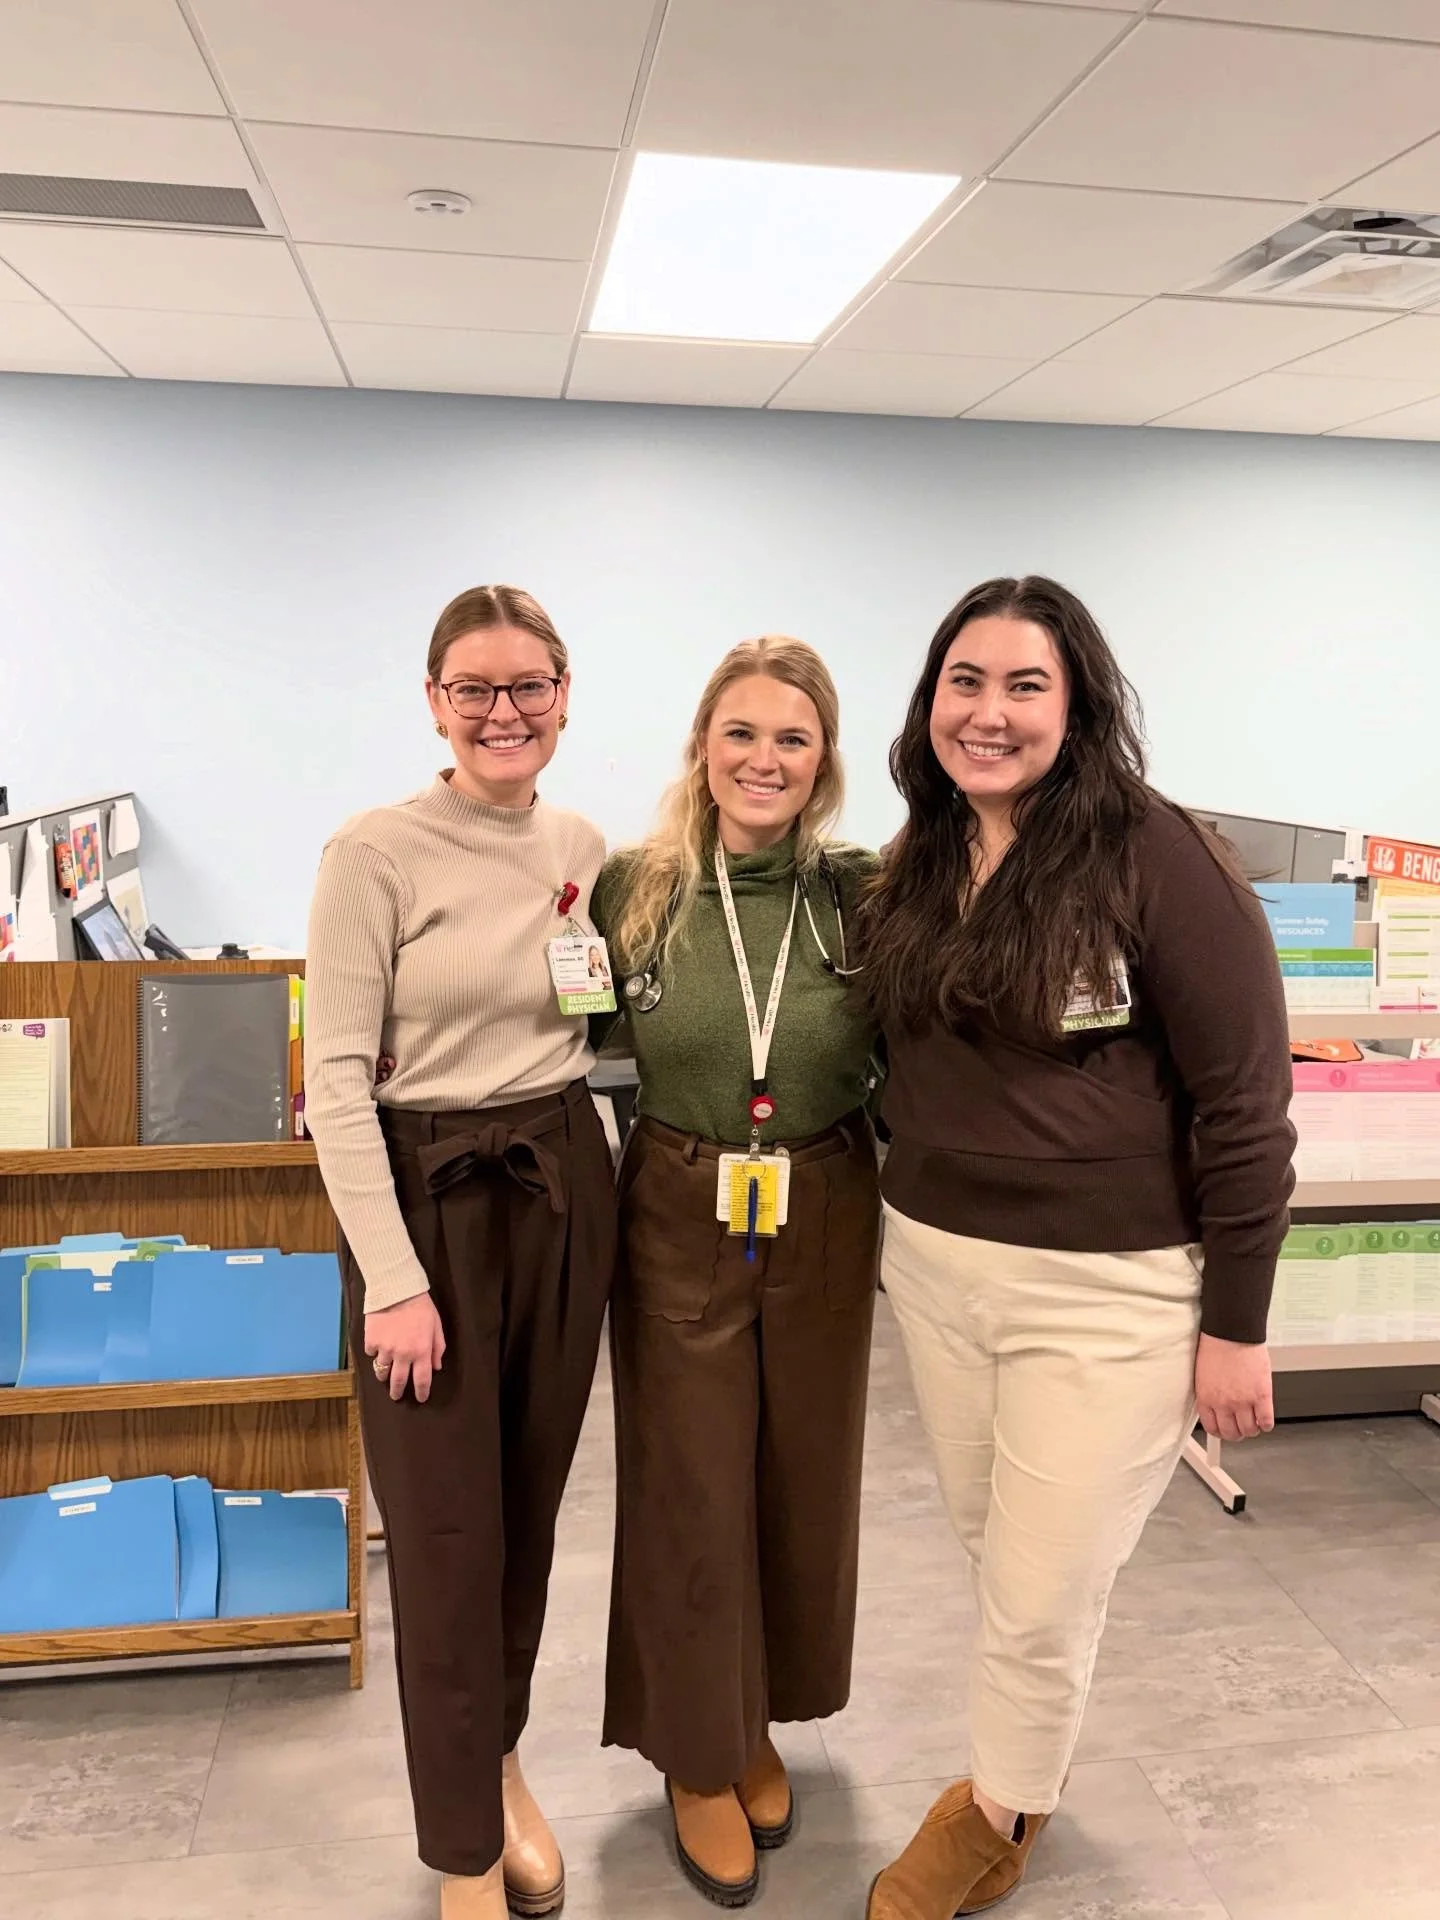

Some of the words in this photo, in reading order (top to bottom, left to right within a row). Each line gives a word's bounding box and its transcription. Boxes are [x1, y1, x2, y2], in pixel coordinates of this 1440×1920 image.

[1402, 850, 1440, 884] BENG
[1277, 927, 1326, 936] RESOURCES
[567, 993, 607, 1004] RESIDENT
[567, 1002, 611, 1014] PHYSICIAN
[1064, 1014, 1121, 1030] PHYSICIAN
